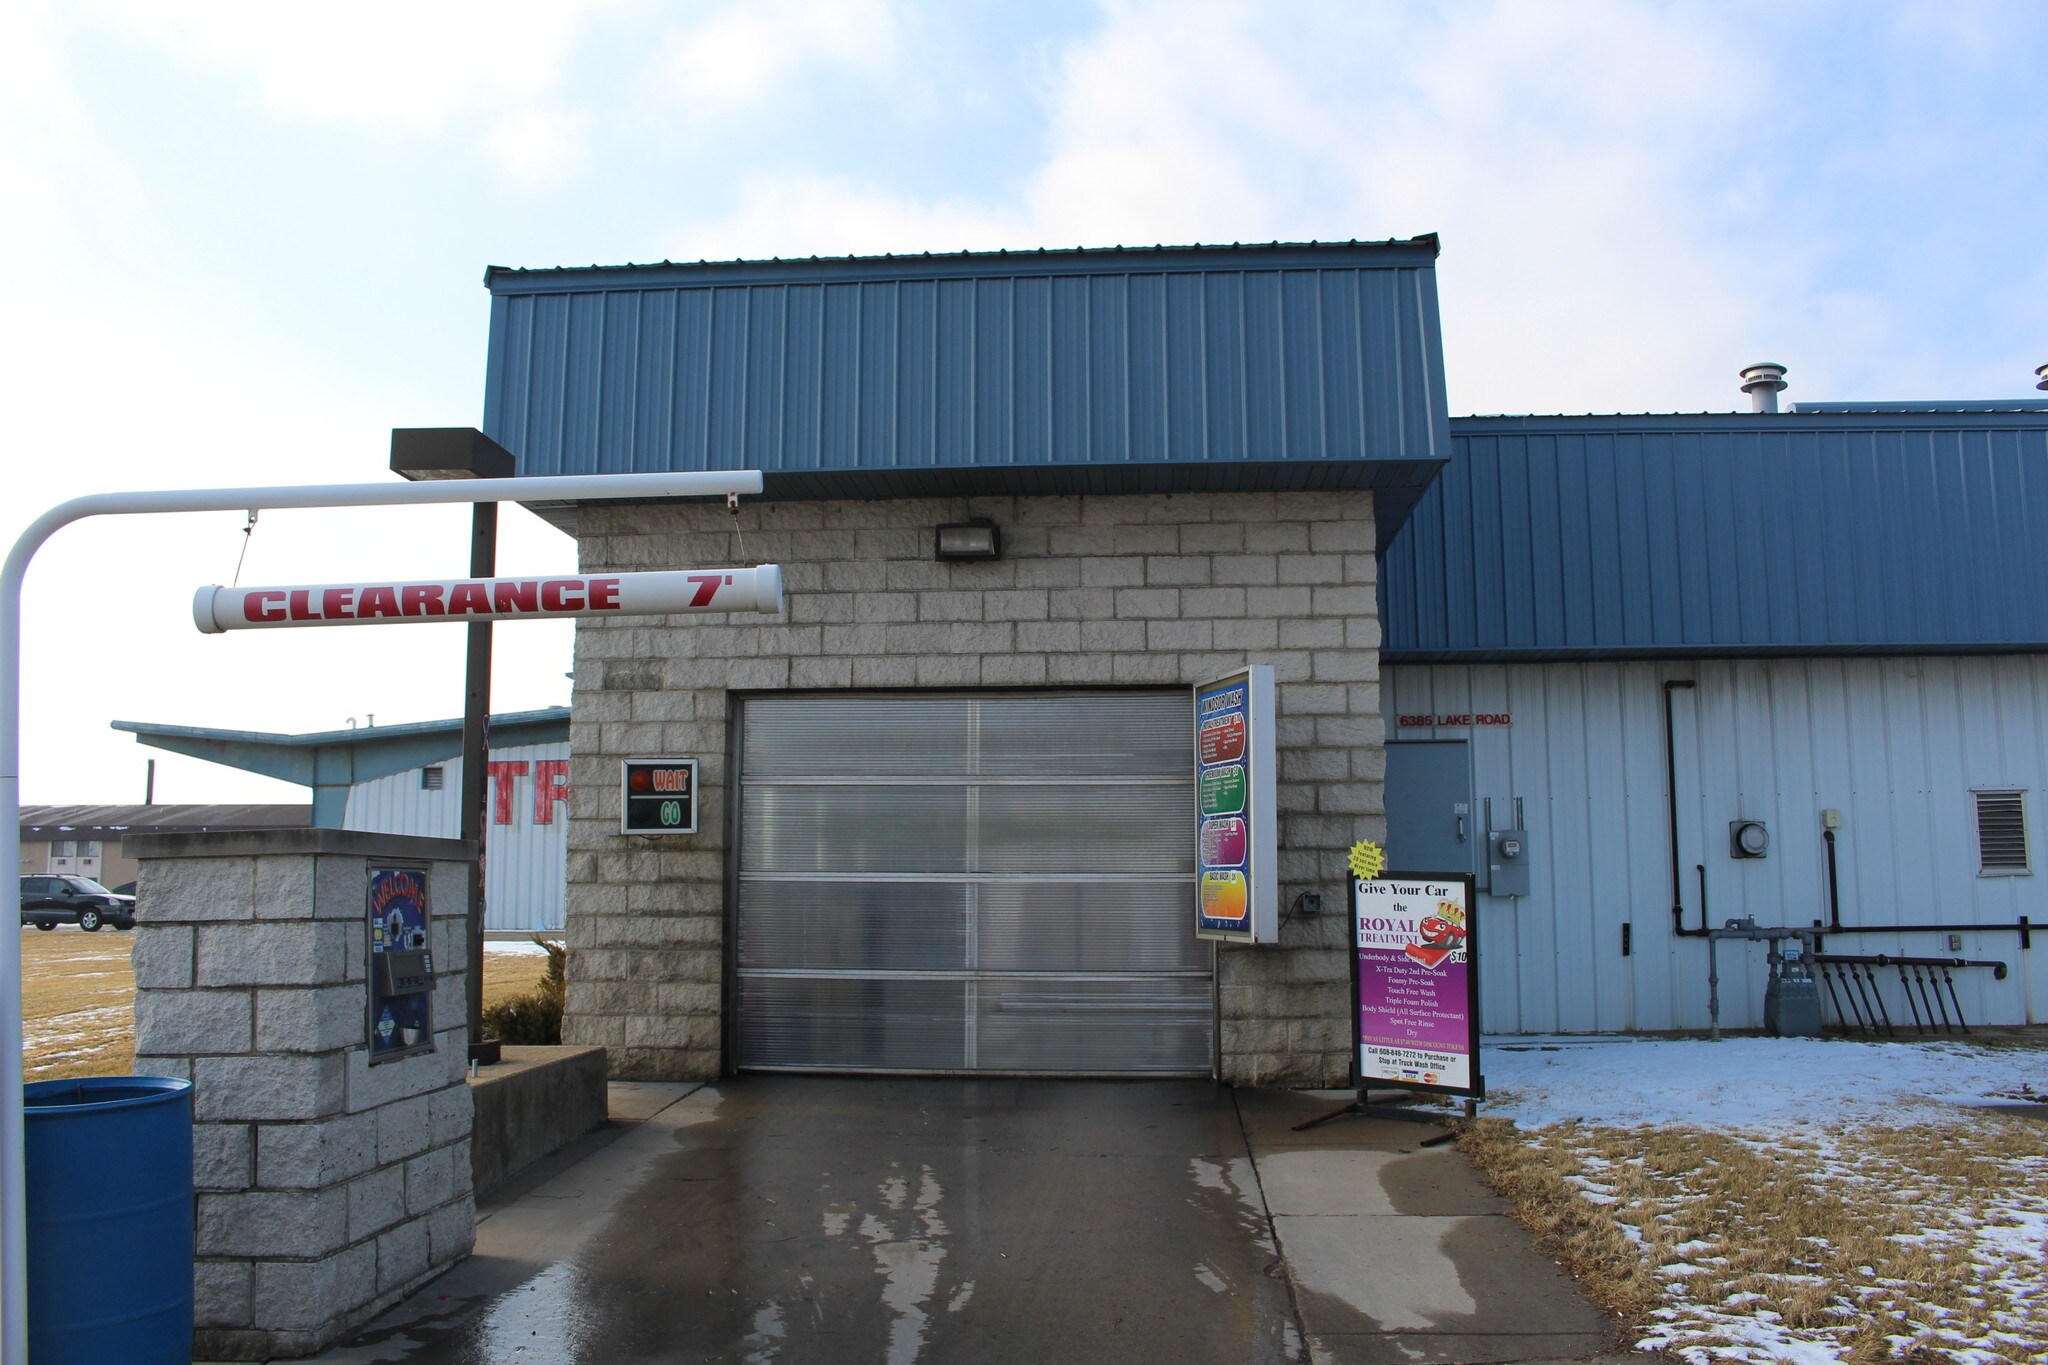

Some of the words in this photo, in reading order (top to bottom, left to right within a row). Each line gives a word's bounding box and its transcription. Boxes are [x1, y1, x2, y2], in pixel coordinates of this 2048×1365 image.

[243, 578, 621, 622] CLEARANCE
[687, 576, 733, 607] 7'
[1225, 688, 1243, 709] WASH
[1399, 715, 1433, 727] 6385
[1437, 714, 1471, 726] LAKE
[1475, 713, 1511, 726] ROAD
[653, 769, 689, 791] WAIT
[660, 801, 681, 825] GO
[1219, 819, 1230, 830] WASH
[1219, 871, 1229, 881] WASH
[372, 873, 425, 917] WELCOME
[1358, 882, 1386, 895] Give
[1390, 883, 1421, 896] Your
[1425, 884, 1449, 897] Car
[1393, 902, 1408, 912] the
[1359, 917, 1418, 933] ROYAL
[1359, 932, 1419, 945] TREATMENT
[1358, 952, 1390, 963] Underbody
[1397, 955, 1410, 963] Side
[1450, 951, 1468, 963] $10
[1376, 965, 1393, 974] X-Tra
[1393, 966, 1408, 975] Duty
[1409, 967, 1420, 975] 2nd
[1421, 968, 1448, 977] Pre-Soak
[1388, 976, 1407, 986] Foamy
[1408, 978, 1435, 987] Pre-Soak
[1388, 986, 1405, 995] Touch
[1406, 988, 1419, 996] Free
[1420, 989, 1436, 997] Wash
[1385, 997, 1403, 1006] Triple
[1403, 998, 1420, 1006] Foam
[1420, 999, 1439, 1008] Polish
[1362, 1004, 1377, 1014] Body
[1378, 1006, 1396, 1015] Shield
[1396, 1007, 1409, 1016] (All
[1409, 1009, 1431, 1017] Surface
[1432, 1010, 1465, 1020] Protectant)
[1390, 1017, 1404, 1026] Spot
[1404, 1018, 1417, 1027] Free
[1418, 1019, 1435, 1028] Rinse
[1406, 1029, 1418, 1038] Dry
[1368, 1046, 1378, 1054] Call
[1417, 1052, 1423, 1060] to
[1424, 1053, 1449, 1062] Purchase
[1378, 1056, 1391, 1065] Stop
[1398, 1059, 1413, 1067] Truck
[1414, 1060, 1429, 1069] Wash
[1430, 1062, 1446, 1070] Office
